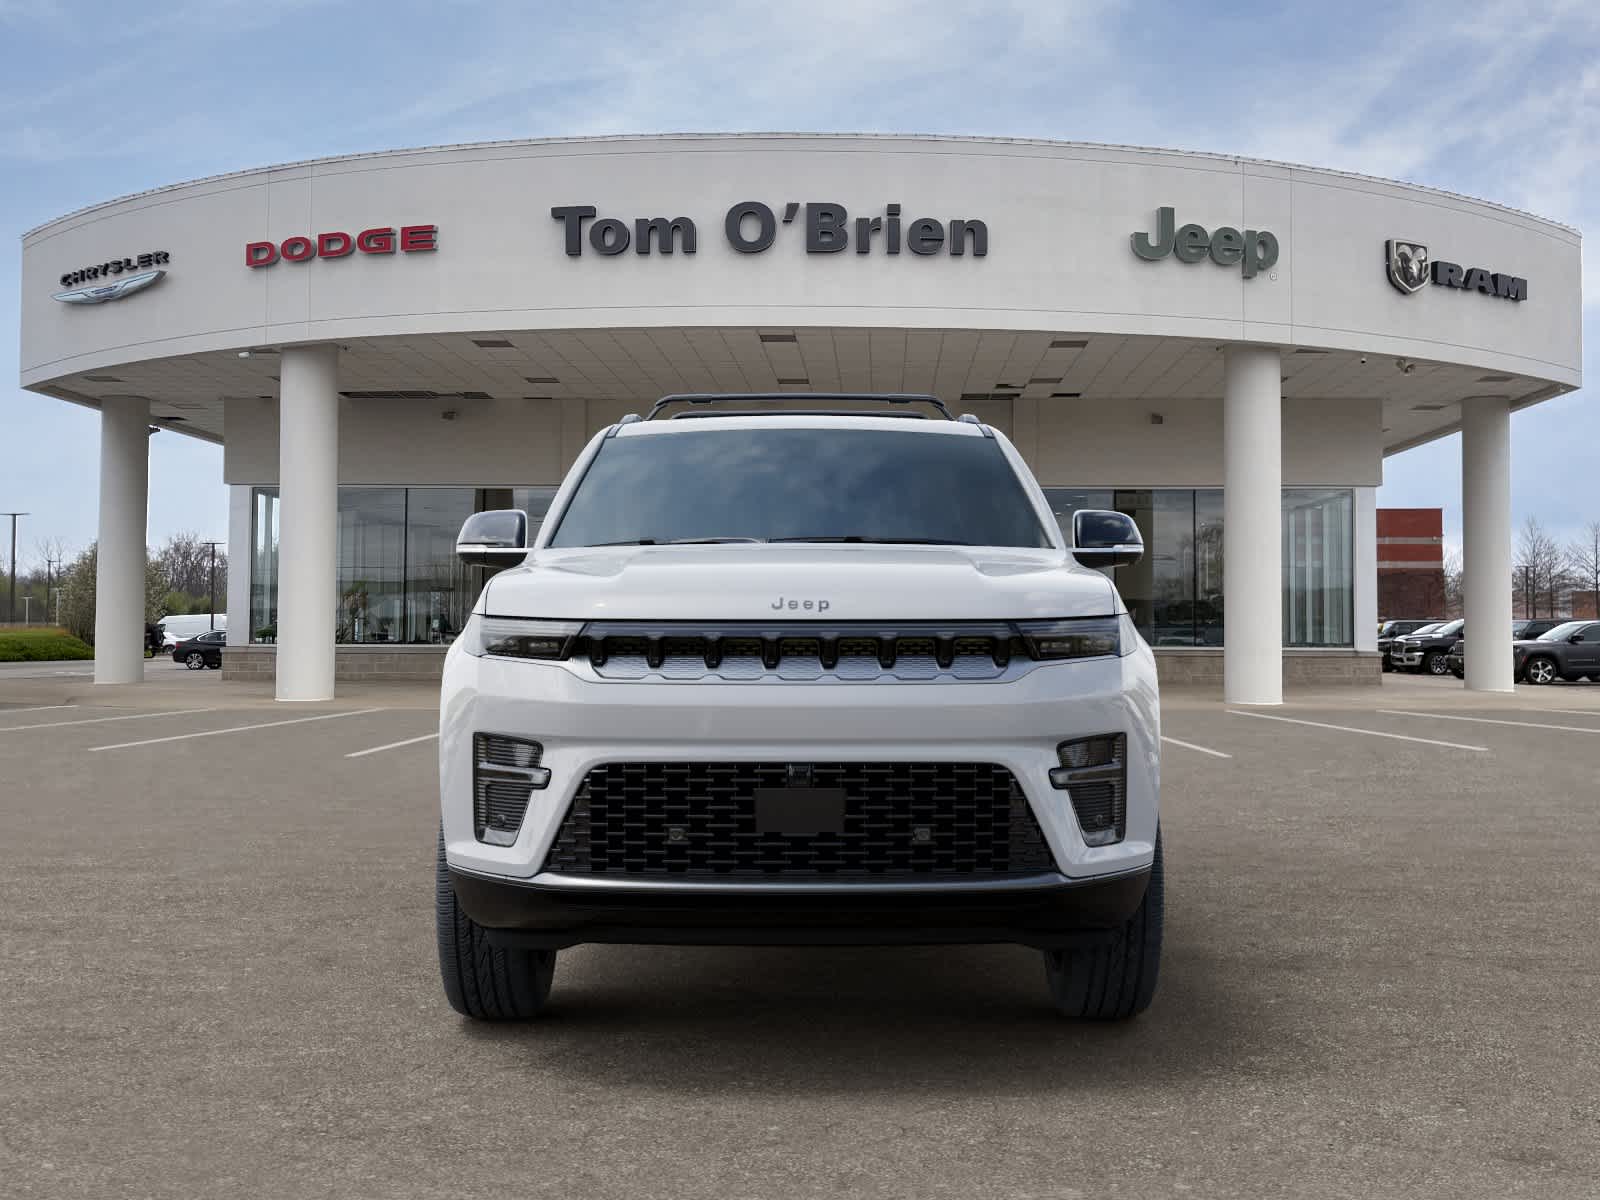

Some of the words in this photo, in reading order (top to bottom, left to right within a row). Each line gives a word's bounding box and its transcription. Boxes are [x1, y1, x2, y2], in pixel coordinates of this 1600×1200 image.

[245, 225, 438, 268] DODGE
[550, 205, 697, 256] Tom
[725, 201, 988, 257] O'Brien
[1130, 206, 1279, 279] Jeep
[60, 250, 169, 287] CHRYSLER
[1430, 260, 1527, 301] RAM
[771, 597, 830, 613] Jeep
